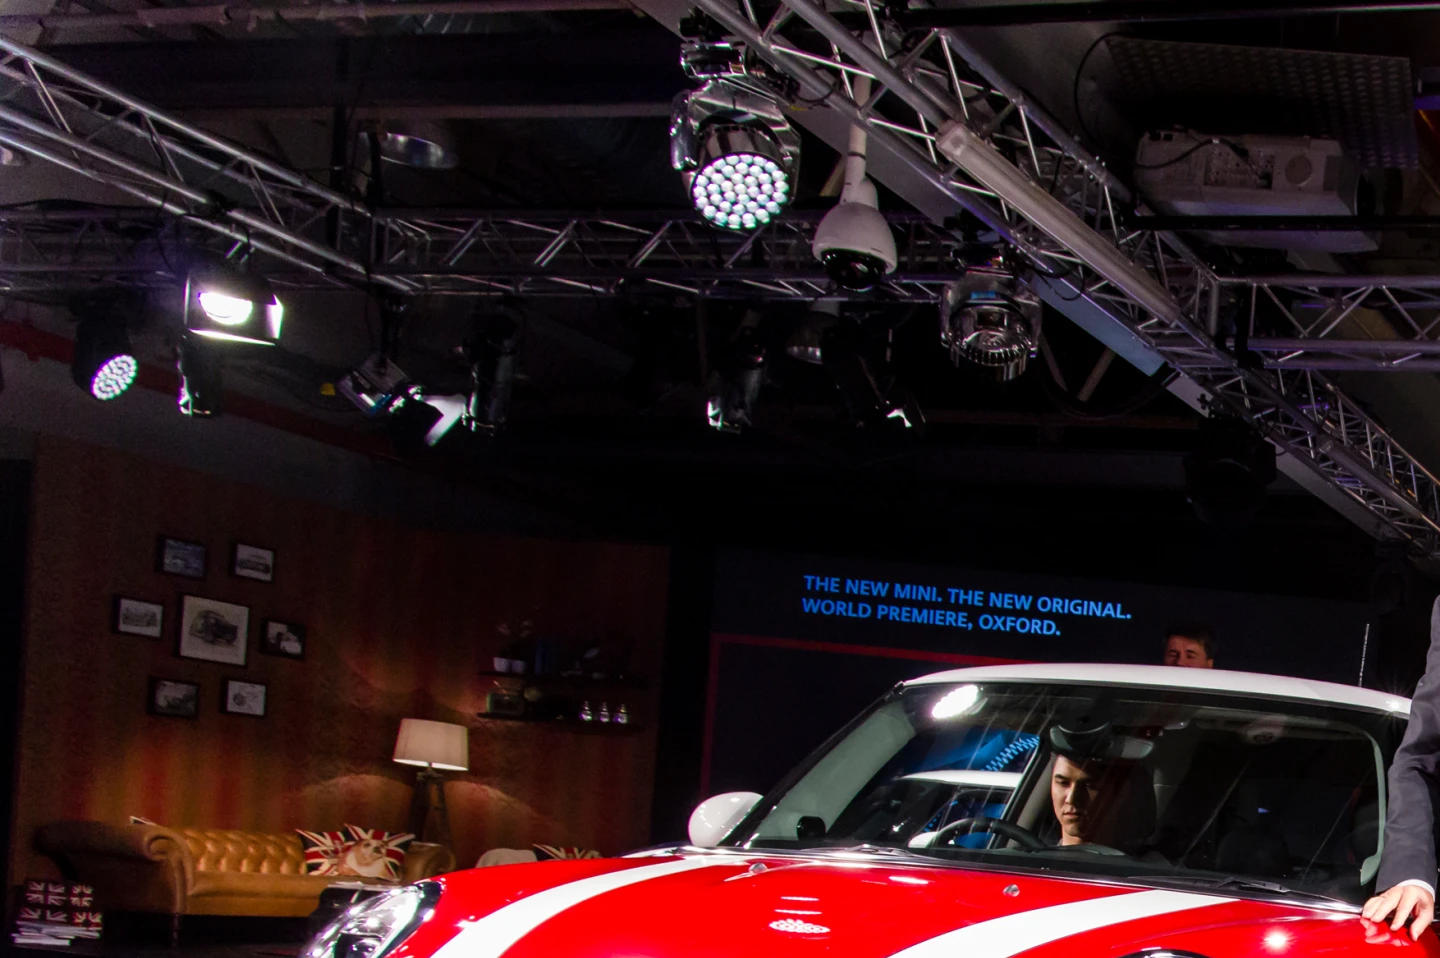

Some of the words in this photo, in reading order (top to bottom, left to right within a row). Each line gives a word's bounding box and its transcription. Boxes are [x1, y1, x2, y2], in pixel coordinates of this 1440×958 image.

[801, 597, 872, 619] WORLD
[876, 604, 973, 631] PREMIERE,
[977, 613, 1061, 636] OXFORD.
[803, 575, 840, 593] THE
[845, 578, 890, 597] NEW
[893, 583, 943, 603] MINI.
[946, 587, 985, 607] THE
[988, 591, 1033, 611] NEW
[1036, 595, 1132, 620] ORIGINAL.
